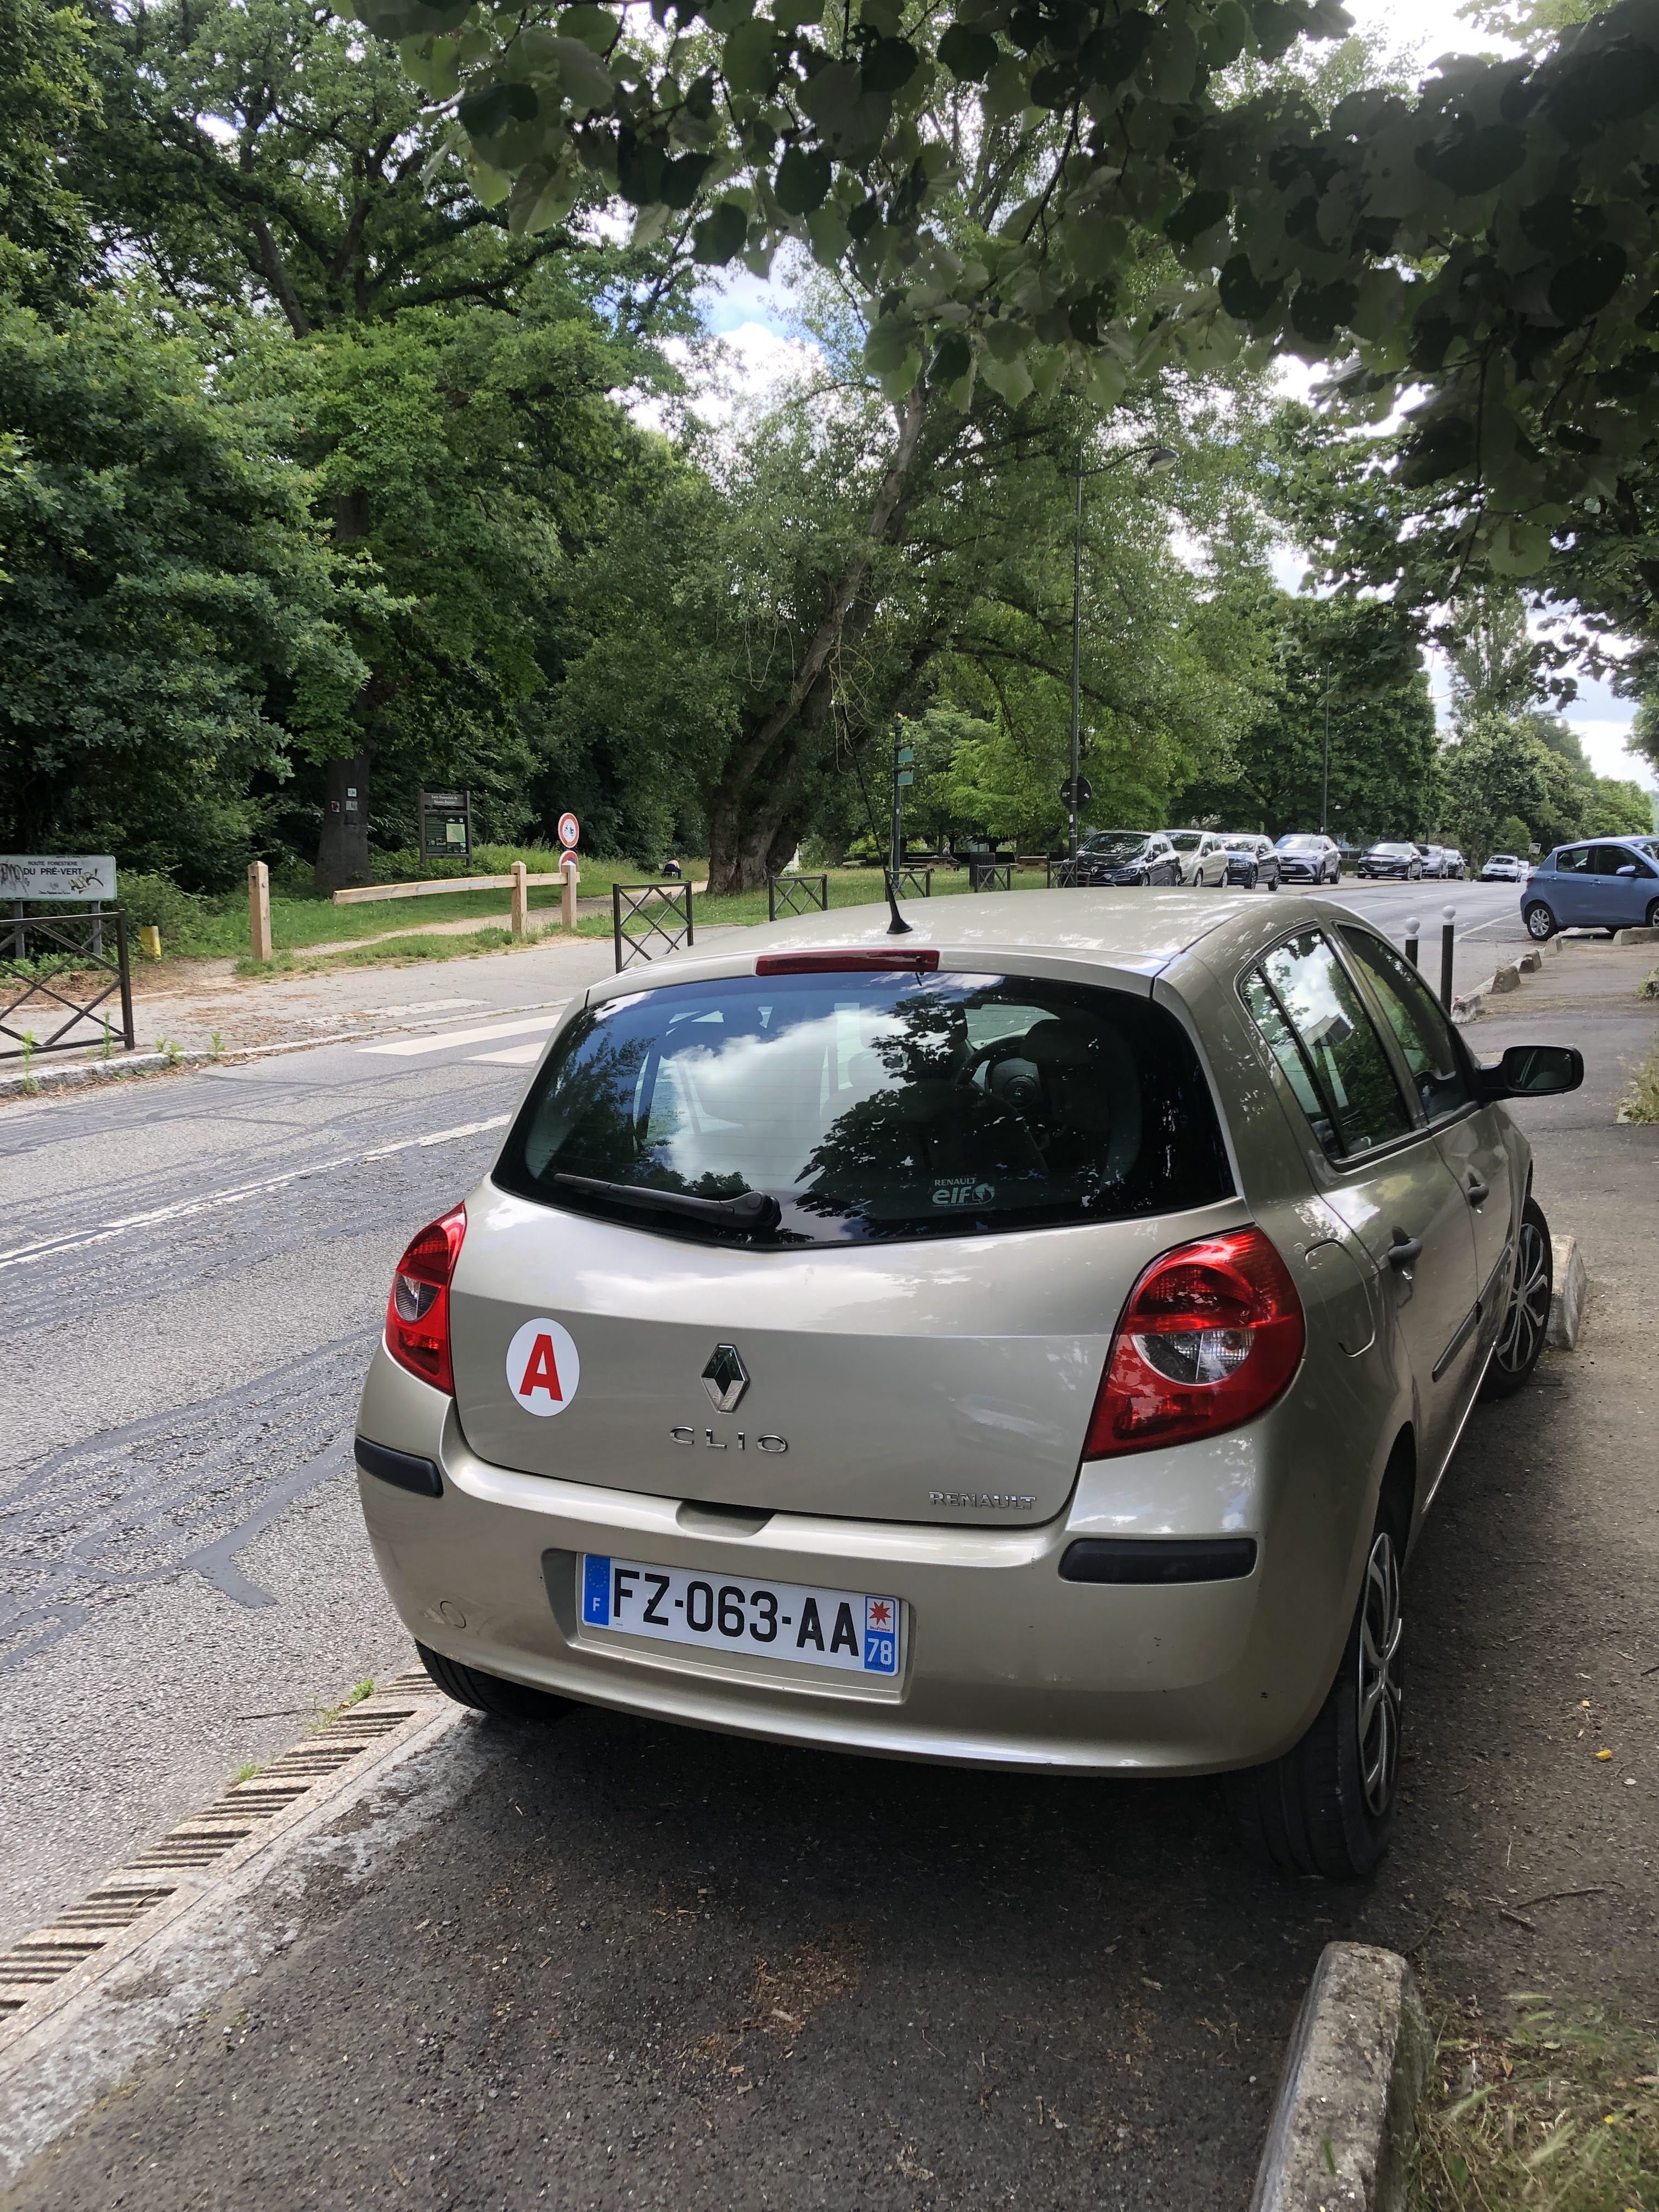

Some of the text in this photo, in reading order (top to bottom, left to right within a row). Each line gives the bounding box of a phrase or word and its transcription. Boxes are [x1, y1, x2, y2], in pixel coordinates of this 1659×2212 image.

[934, 1177, 977, 1186] RENAULT
[933, 1186, 972, 1204] elf
[519, 1333, 563, 1402] A
[669, 1426, 788, 1453] CLIO
[928, 1491, 1036, 1510] RENAULT
[592, 1597, 601, 1611] F
[613, 1567, 860, 1657] FZ-063-AA
[867, 1637, 893, 1666] 78
